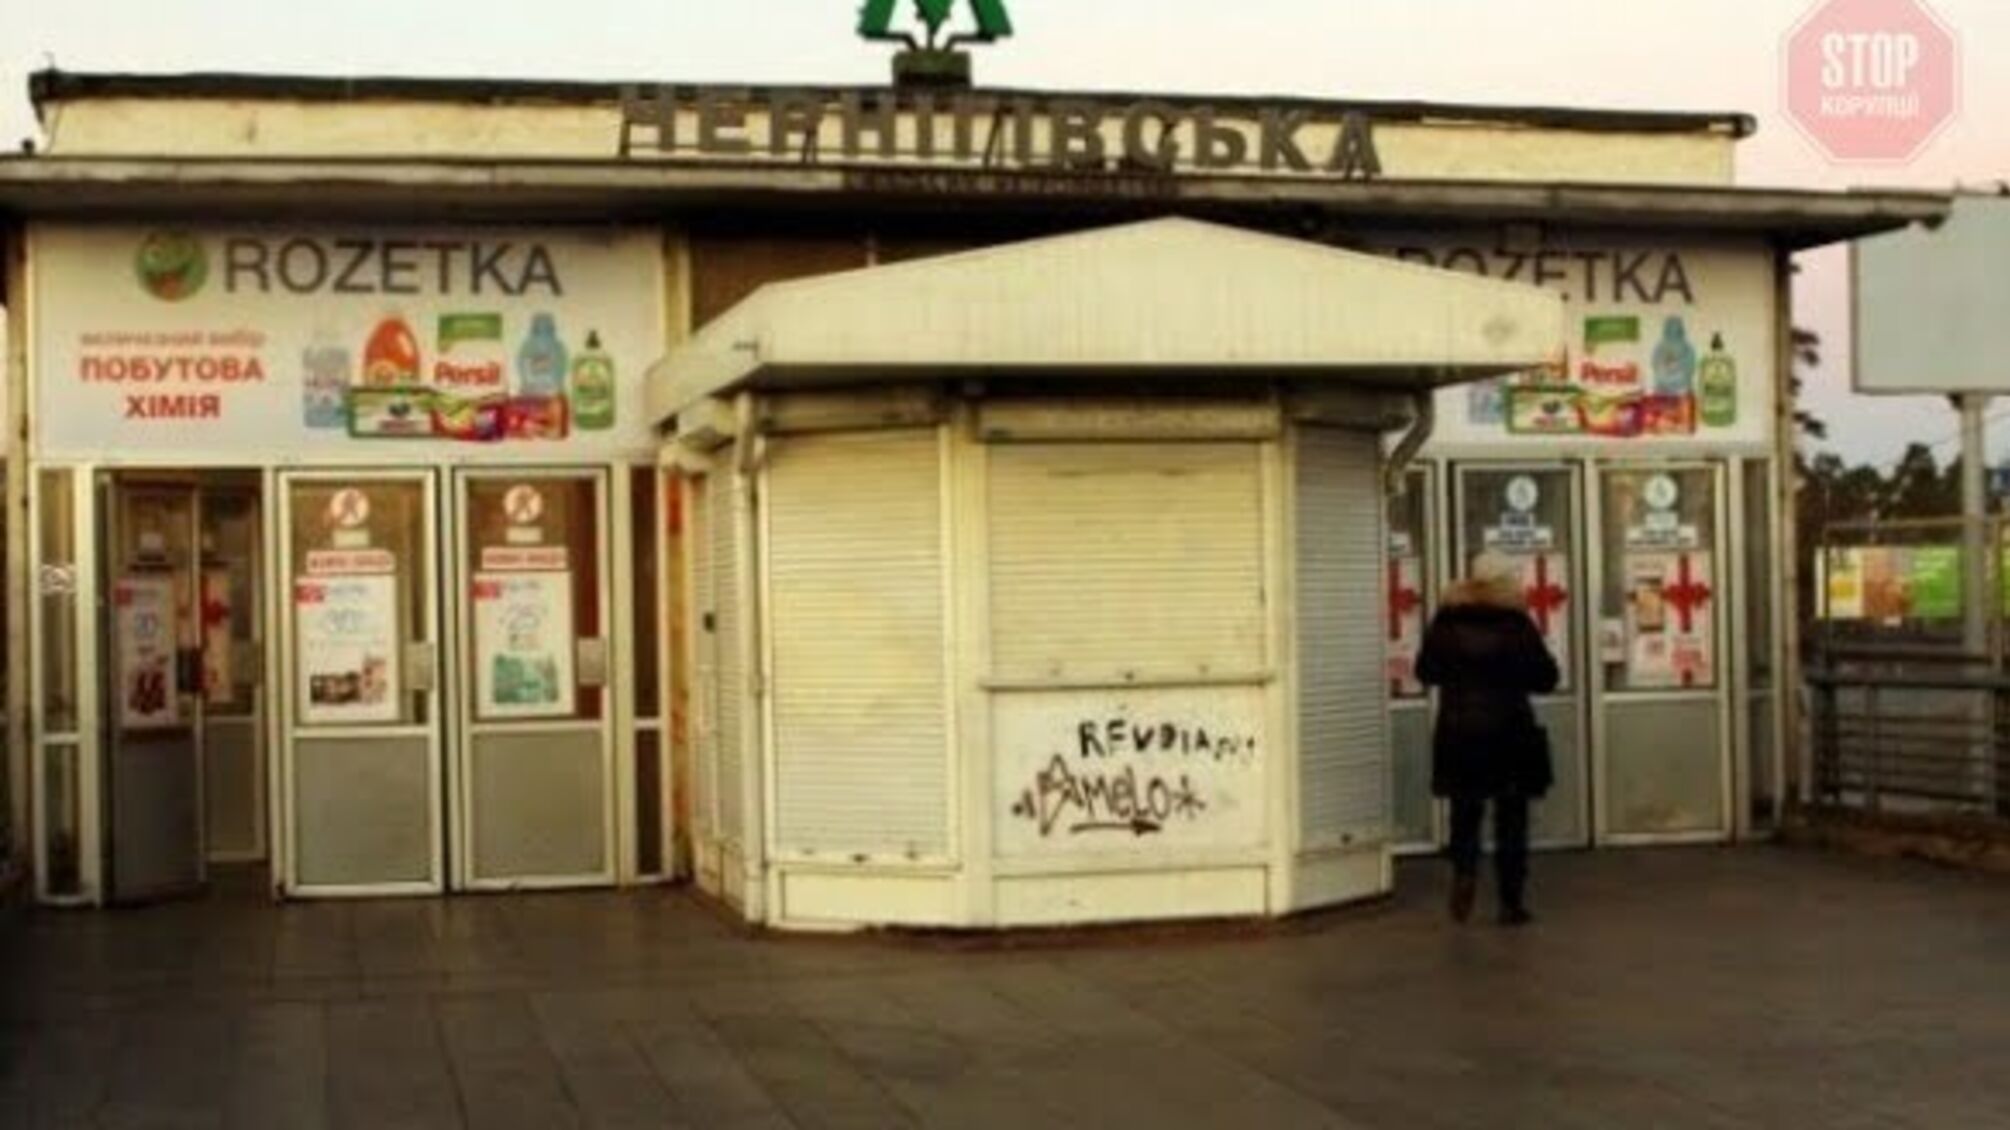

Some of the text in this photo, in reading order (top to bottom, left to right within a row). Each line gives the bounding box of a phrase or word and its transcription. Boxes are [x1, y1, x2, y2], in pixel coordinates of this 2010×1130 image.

[223, 237, 563, 296] ROZETKA
[80, 356, 264, 381] ПОБУТОВА
[126, 395, 220, 418] ХІМІЯ
